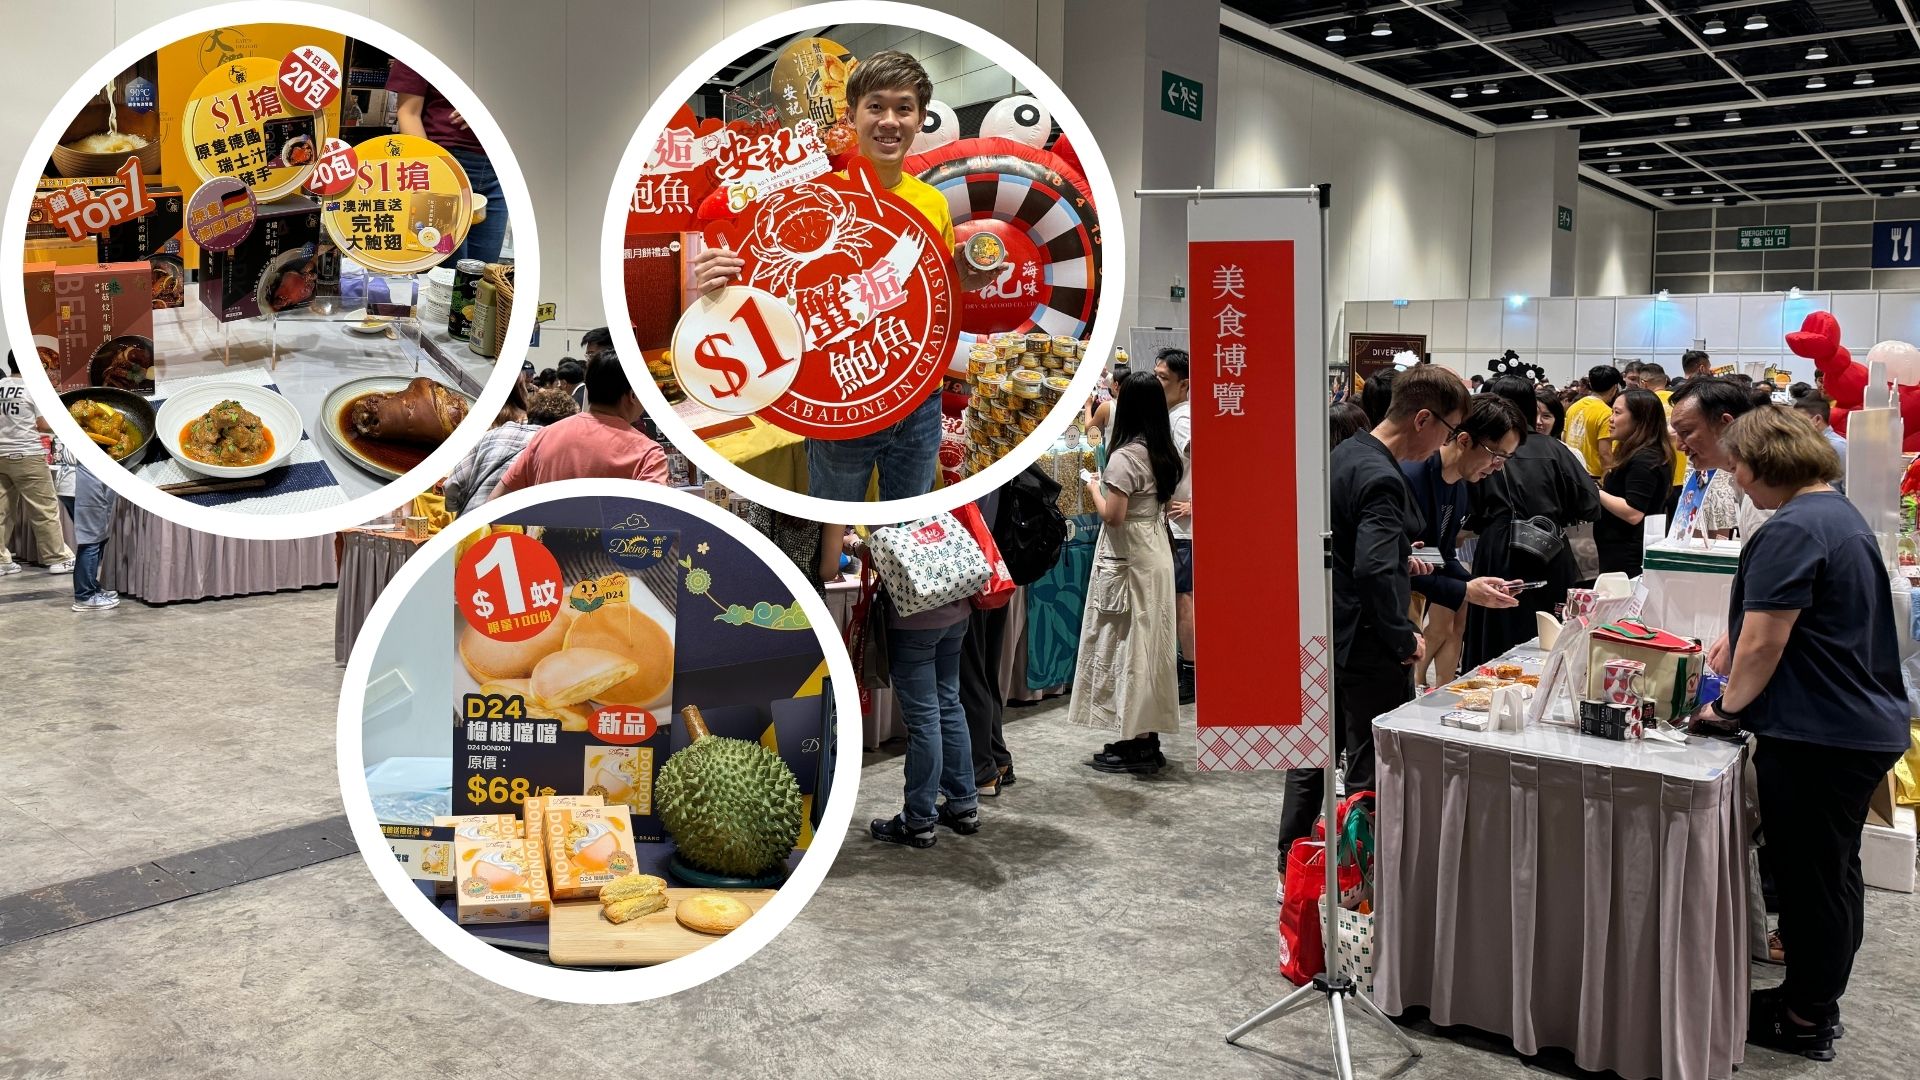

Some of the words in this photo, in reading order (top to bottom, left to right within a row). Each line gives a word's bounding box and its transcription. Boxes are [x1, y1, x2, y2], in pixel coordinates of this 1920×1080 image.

[303, 48, 339, 80] 首日限量
[280, 61, 331, 109] 20包
[210, 85, 282, 133] $1搶
[195, 127, 262, 161] 原隻德國
[216, 147, 265, 174] 瑞士汁
[229, 165, 272, 187] 豬手
[310, 153, 356, 190] 20包
[357, 160, 430, 194] $1搶
[50, 186, 89, 213] 銷售
[342, 197, 403, 213] 澳洲直送
[1075, 197, 1086, 207] 4
[351, 213, 395, 233] 完梳
[346, 234, 402, 251] 大鮑翅
[1741, 237, 1786, 247] 緊急出口
[922, 252, 947, 313] PASTE
[979, 263, 1023, 301] 記
[1022, 260, 1040, 297] 海味
[56, 276, 88, 348] BEEF
[694, 296, 795, 398] $1
[915, 324, 945, 376] CRAB
[1212, 263, 1248, 417] 美食博覽
[828, 316, 921, 400] 鮑魚
[893, 379, 914, 401] IN
[786, 397, 888, 422] ABALONE
[605, 590, 624, 599] D24
[488, 610, 552, 634] 限量100份
[467, 698, 522, 719] D24
[598, 711, 646, 736] 新品
[467, 720, 558, 744] 榴槤噹噹
[638, 749, 652, 813] DONDON
[549, 812, 570, 886] DONDON
[525, 840, 547, 900] DONDON
